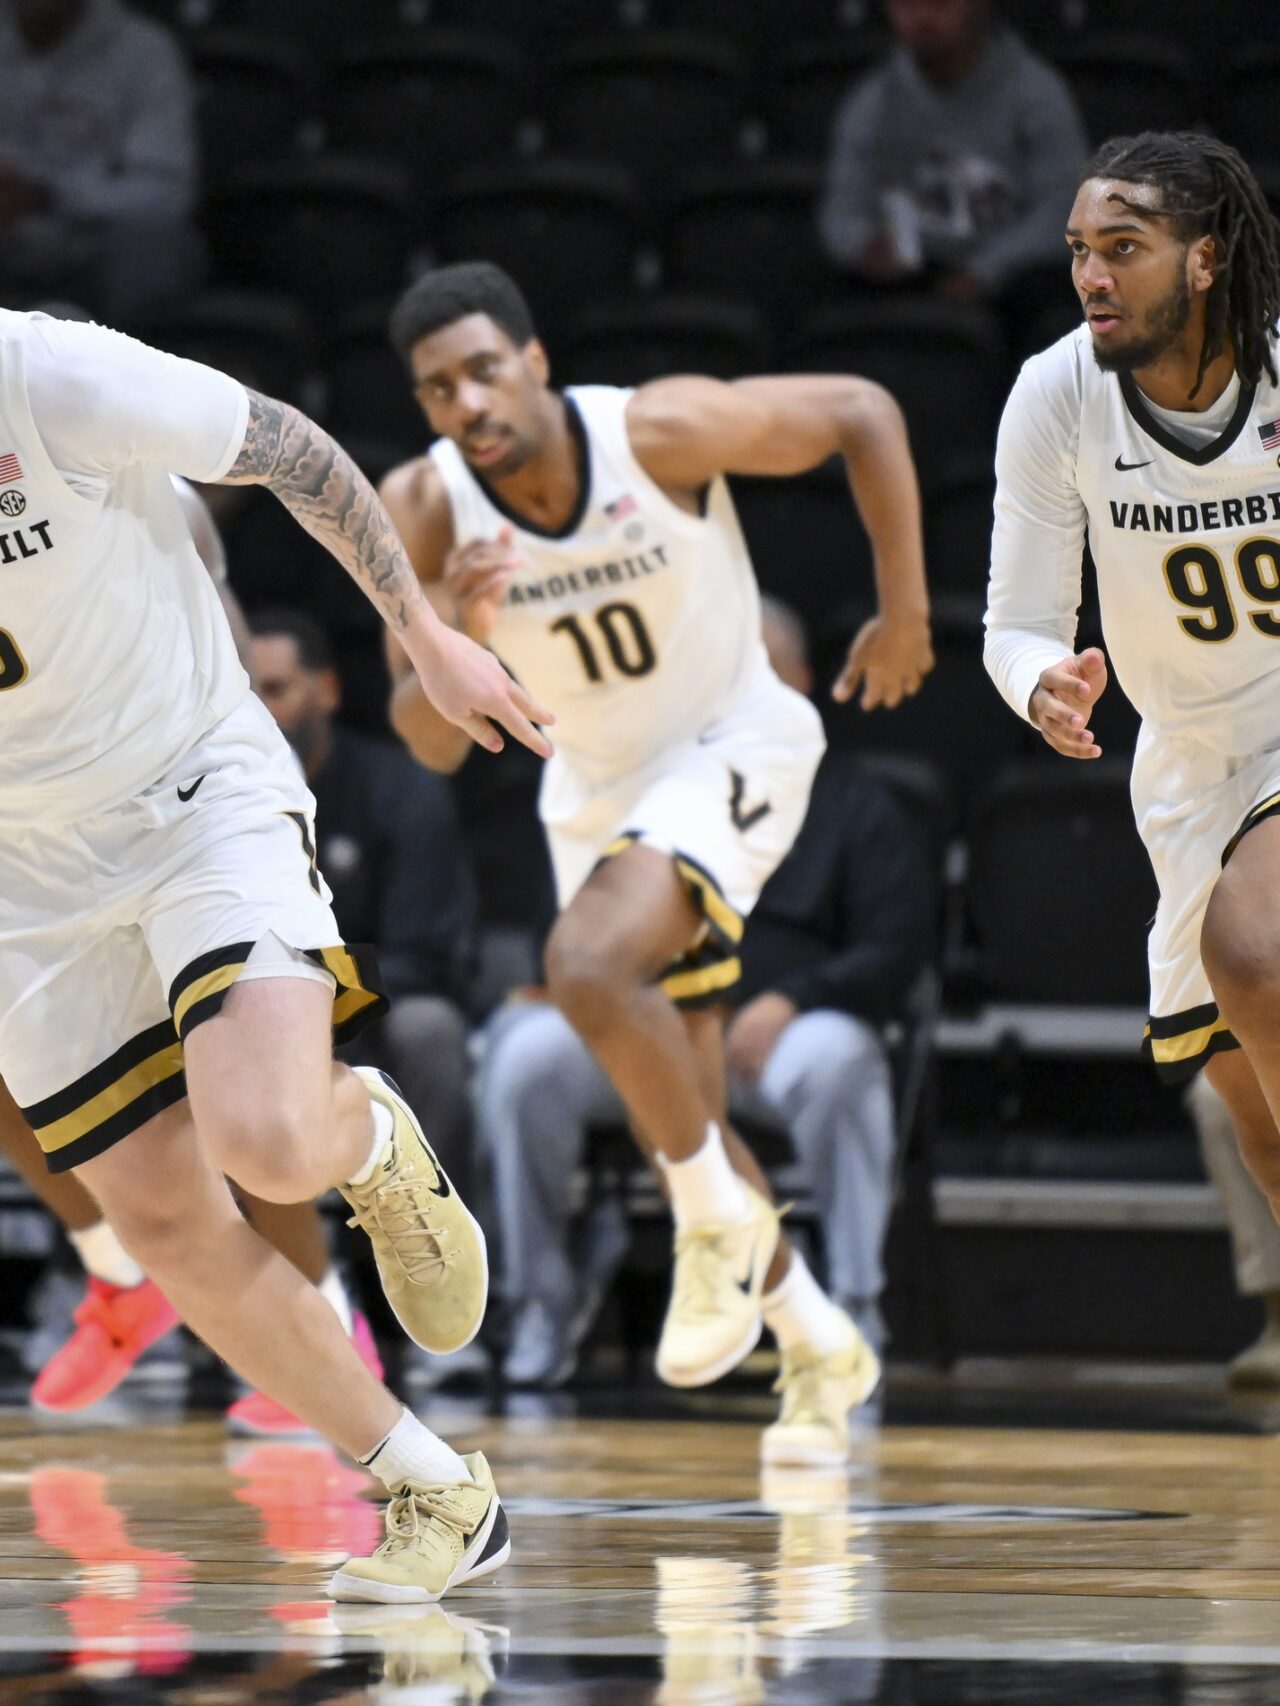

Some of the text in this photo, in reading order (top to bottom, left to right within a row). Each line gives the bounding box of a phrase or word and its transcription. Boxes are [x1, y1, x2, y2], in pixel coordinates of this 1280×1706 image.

[0, 490, 26, 517] SEC
[502, 545, 668, 605] ANDERBILT
[1162, 536, 1280, 644] 99
[549, 599, 658, 684] 10
